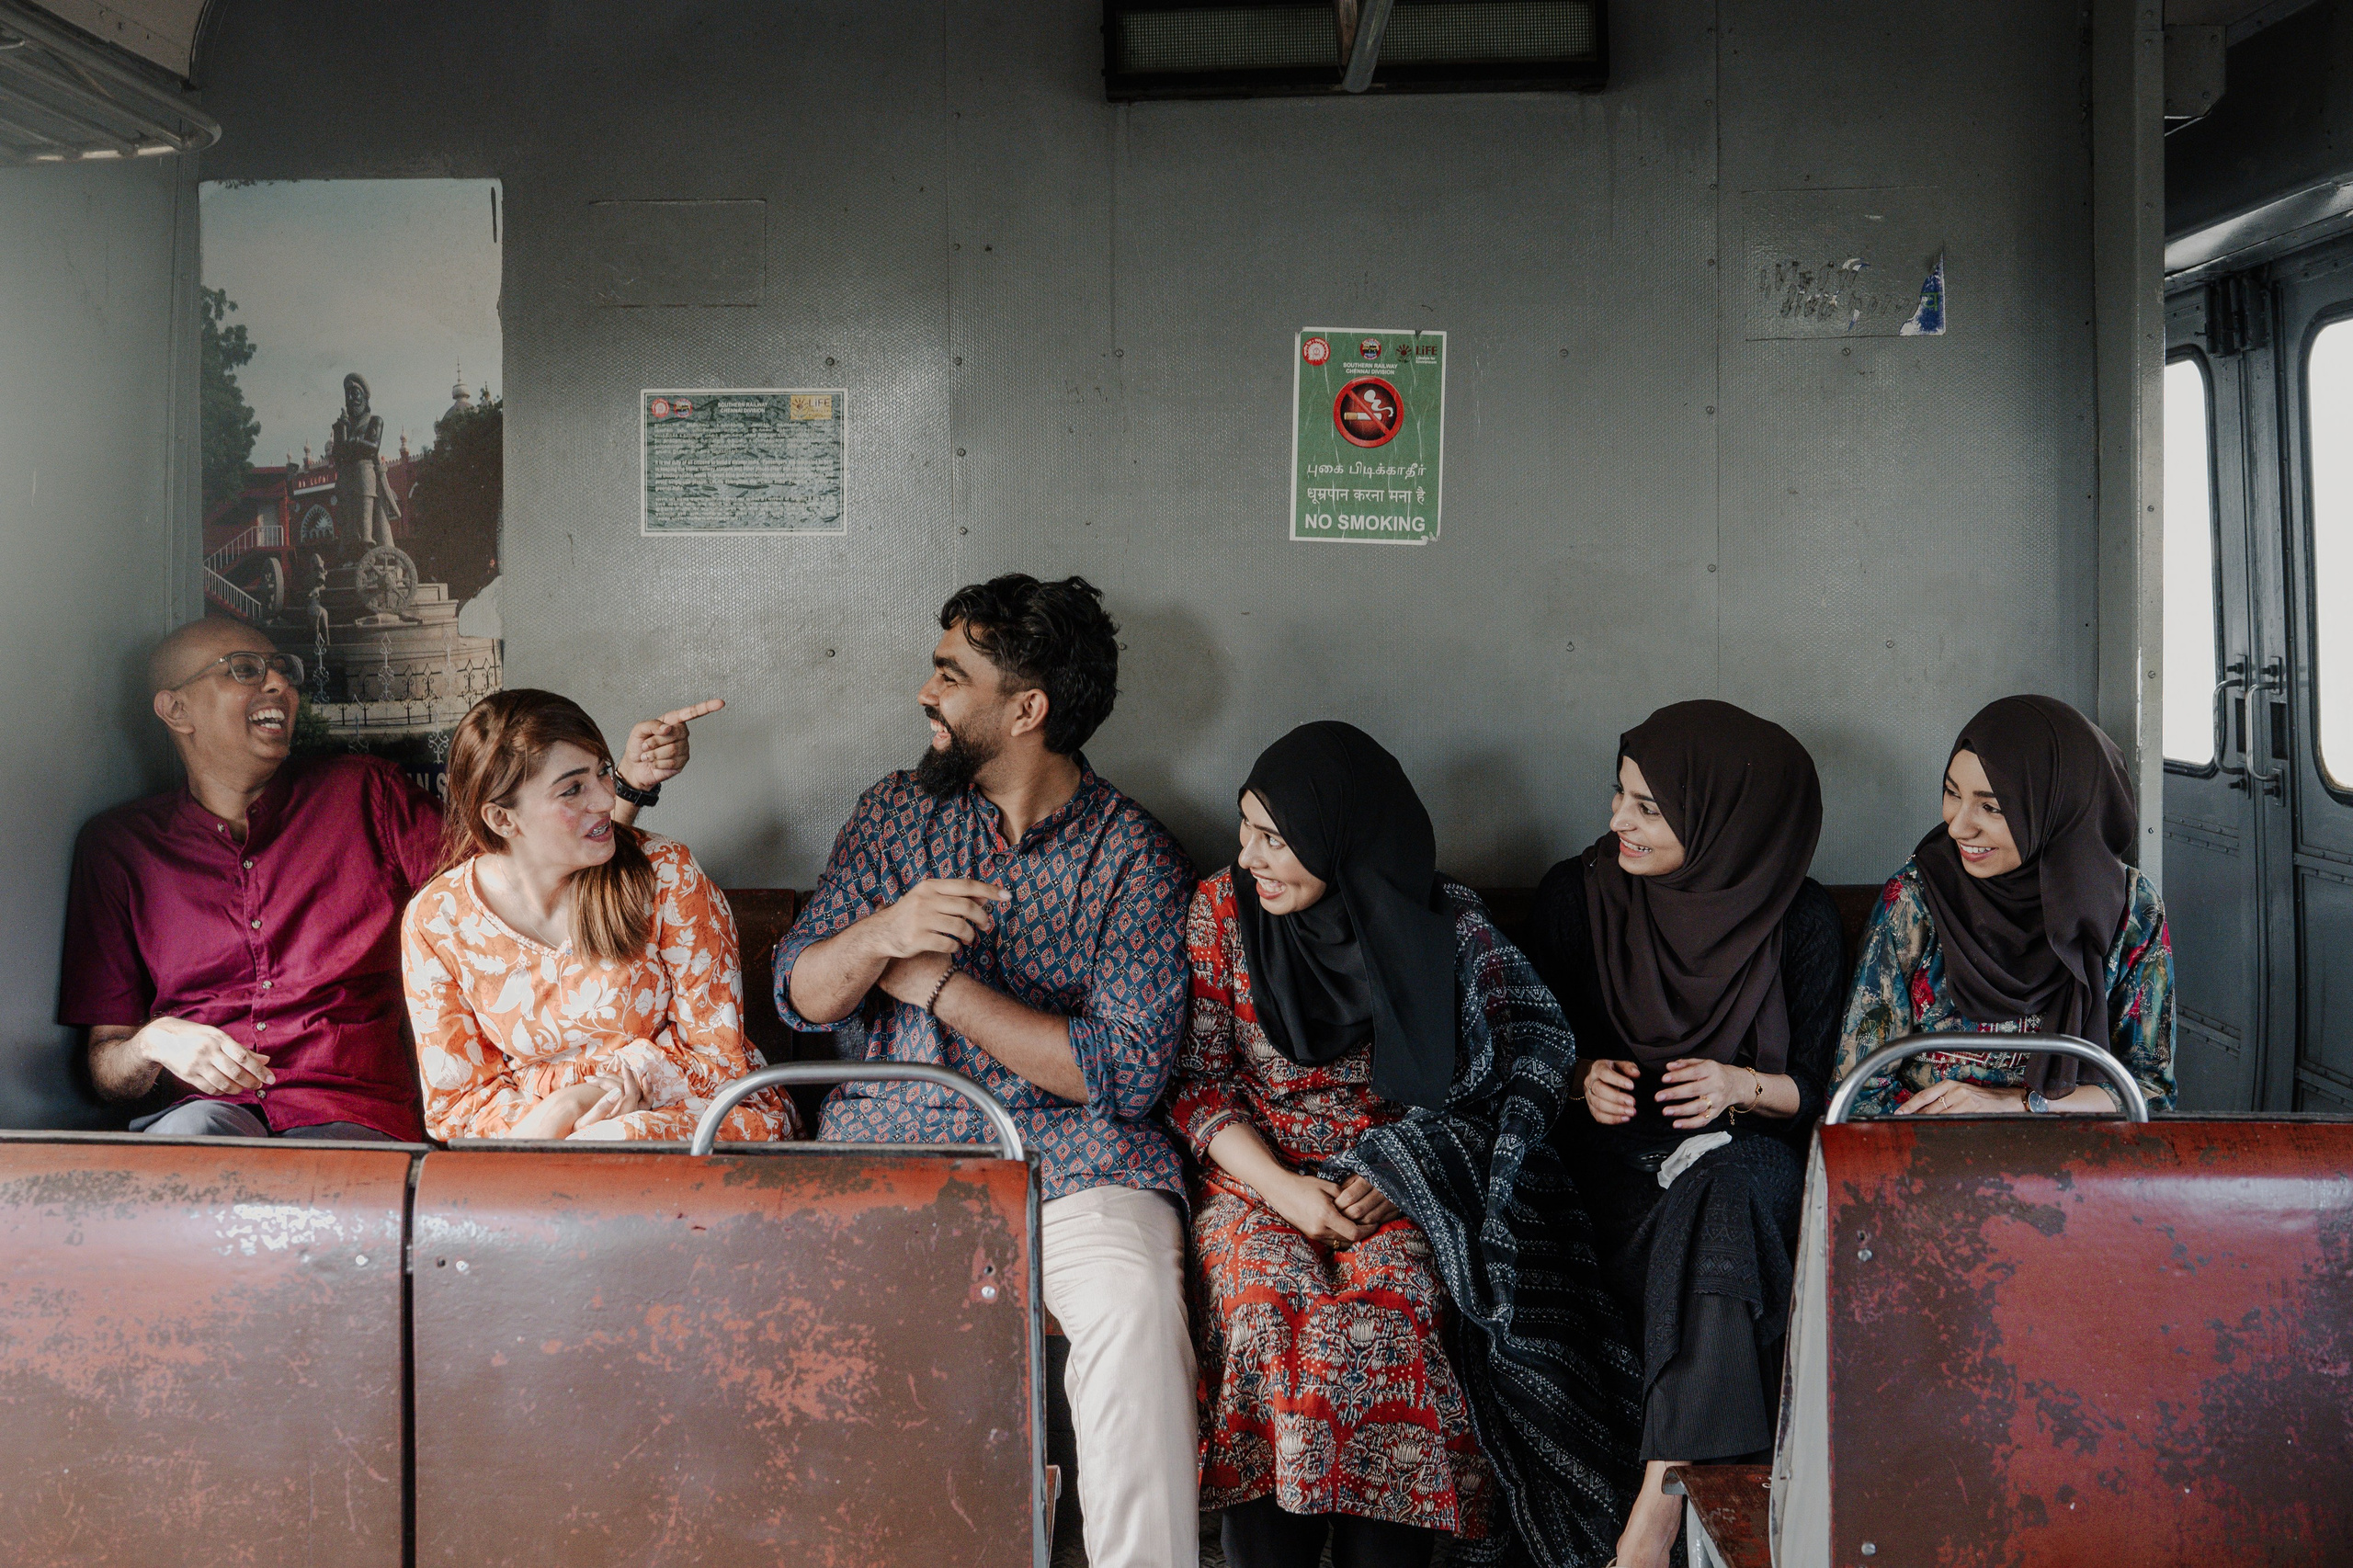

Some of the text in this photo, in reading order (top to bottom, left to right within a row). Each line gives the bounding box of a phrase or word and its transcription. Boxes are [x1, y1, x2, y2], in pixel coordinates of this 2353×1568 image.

[1307, 461, 1427, 479] புகை பிடிக்காதீர்
[1307, 485, 1426, 505] धूम्रपान करना मना है
[1304, 513, 1426, 532] NO SMOKING
